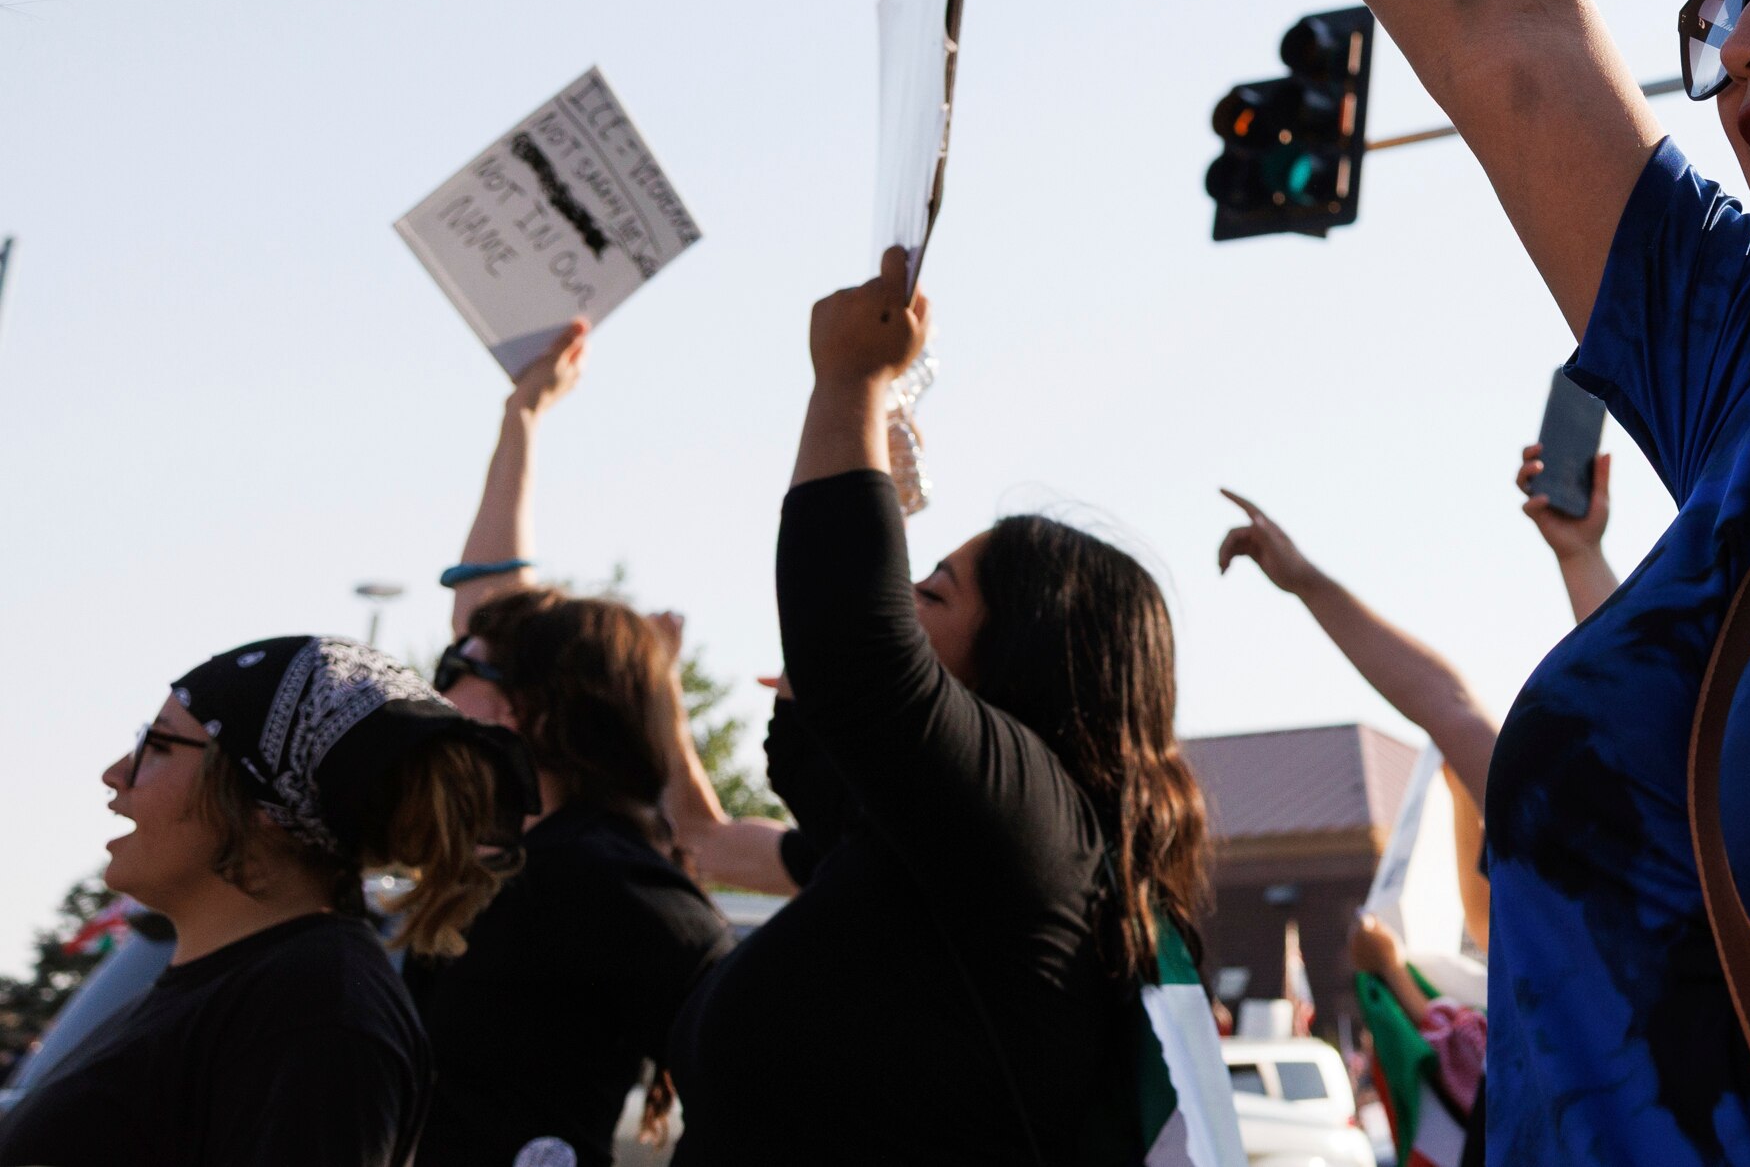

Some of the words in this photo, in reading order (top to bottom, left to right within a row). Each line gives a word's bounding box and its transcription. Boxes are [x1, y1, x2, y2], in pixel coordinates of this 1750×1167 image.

[437, 195, 520, 278] NAME
[473, 157, 527, 204] NOT
[513, 199, 563, 251] IN
